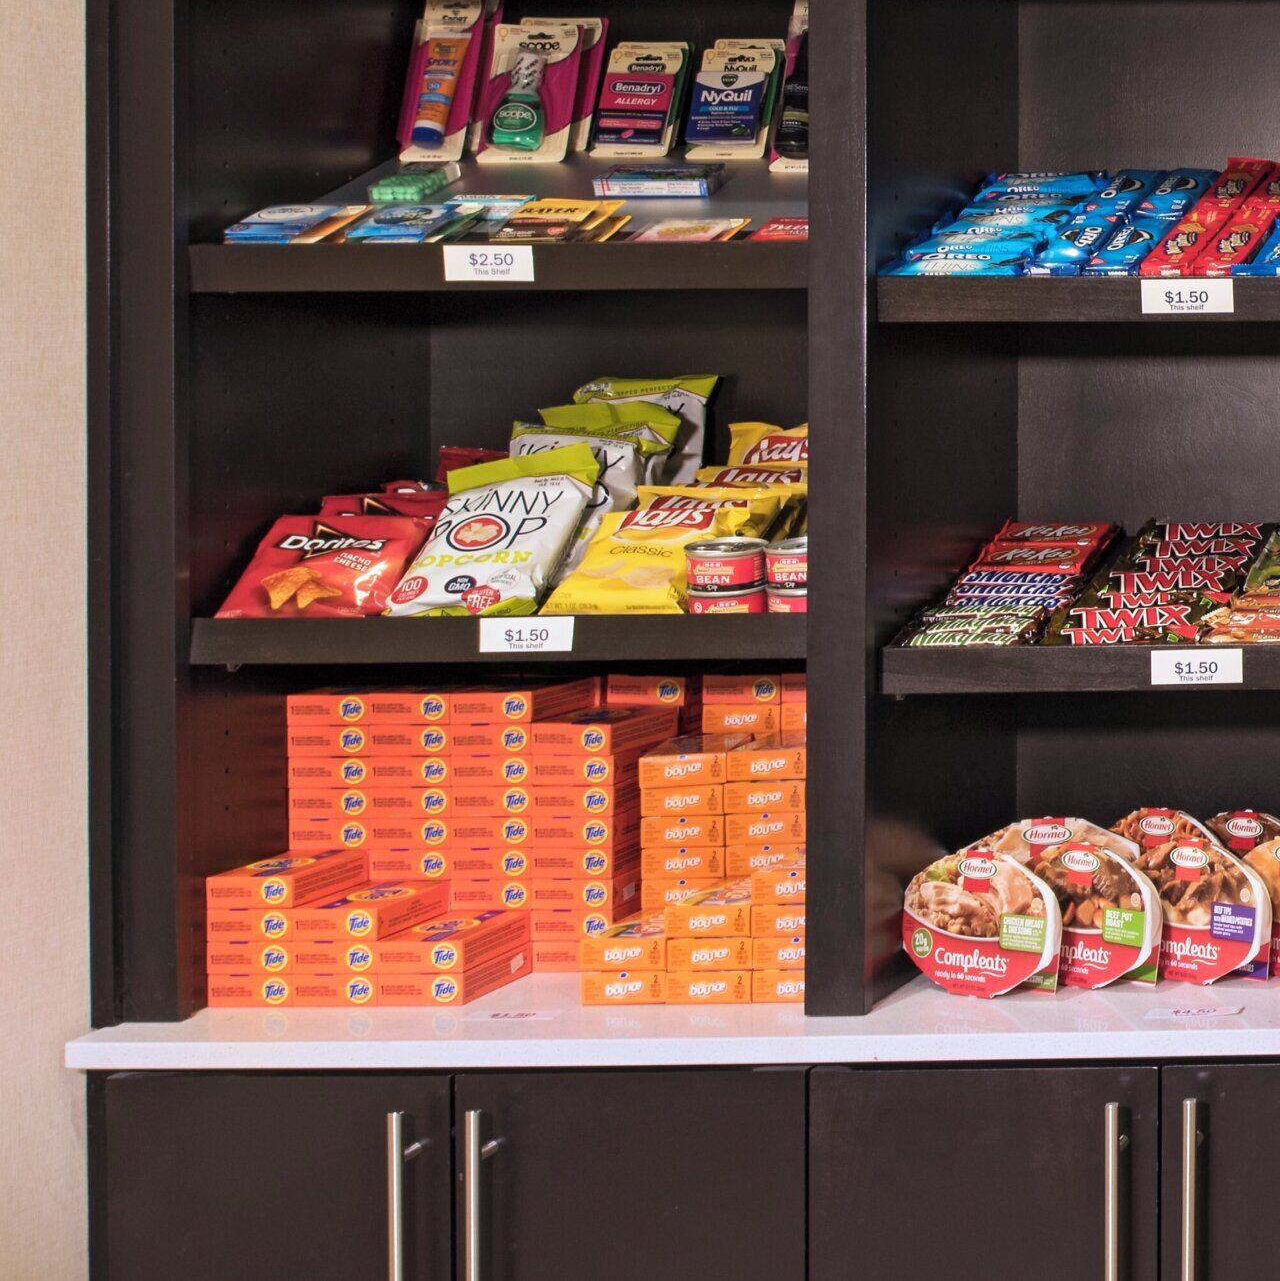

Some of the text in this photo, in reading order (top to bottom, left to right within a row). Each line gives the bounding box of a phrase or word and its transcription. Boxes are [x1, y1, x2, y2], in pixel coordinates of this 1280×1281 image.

[615, 83, 661, 93] Benadryl
[701, 90, 753, 105] NyQuil
[469, 252, 514, 268] $2.50
[1165, 291, 1208, 304] $1.50
[1166, 522, 1264, 540] TWIX
[279, 536, 386, 552] Doritos
[334, 557, 369, 573] CHEESE
[340, 553, 371, 565] NACHO
[775, 573, 807, 581] BEAN
[402, 579, 422, 591] 100
[448, 583, 471, 591] GMO
[467, 595, 495, 608] FREE
[1070, 605, 1193, 629] TWIX
[504, 629, 548, 642] $1.50
[1174, 662, 1218, 674] $1.50
[342, 703, 362, 715] Tide
[1028, 829, 1067, 841] Hormel
[964, 863, 994, 874] Hormel
[264, 885, 285, 898] Tide
[935, 948, 1007, 971] Compleats
[935, 971, 950, 983] ready
[957, 972, 964, 980] 60
[965, 973, 985, 983] seconds
[433, 982, 455, 995] Tide
